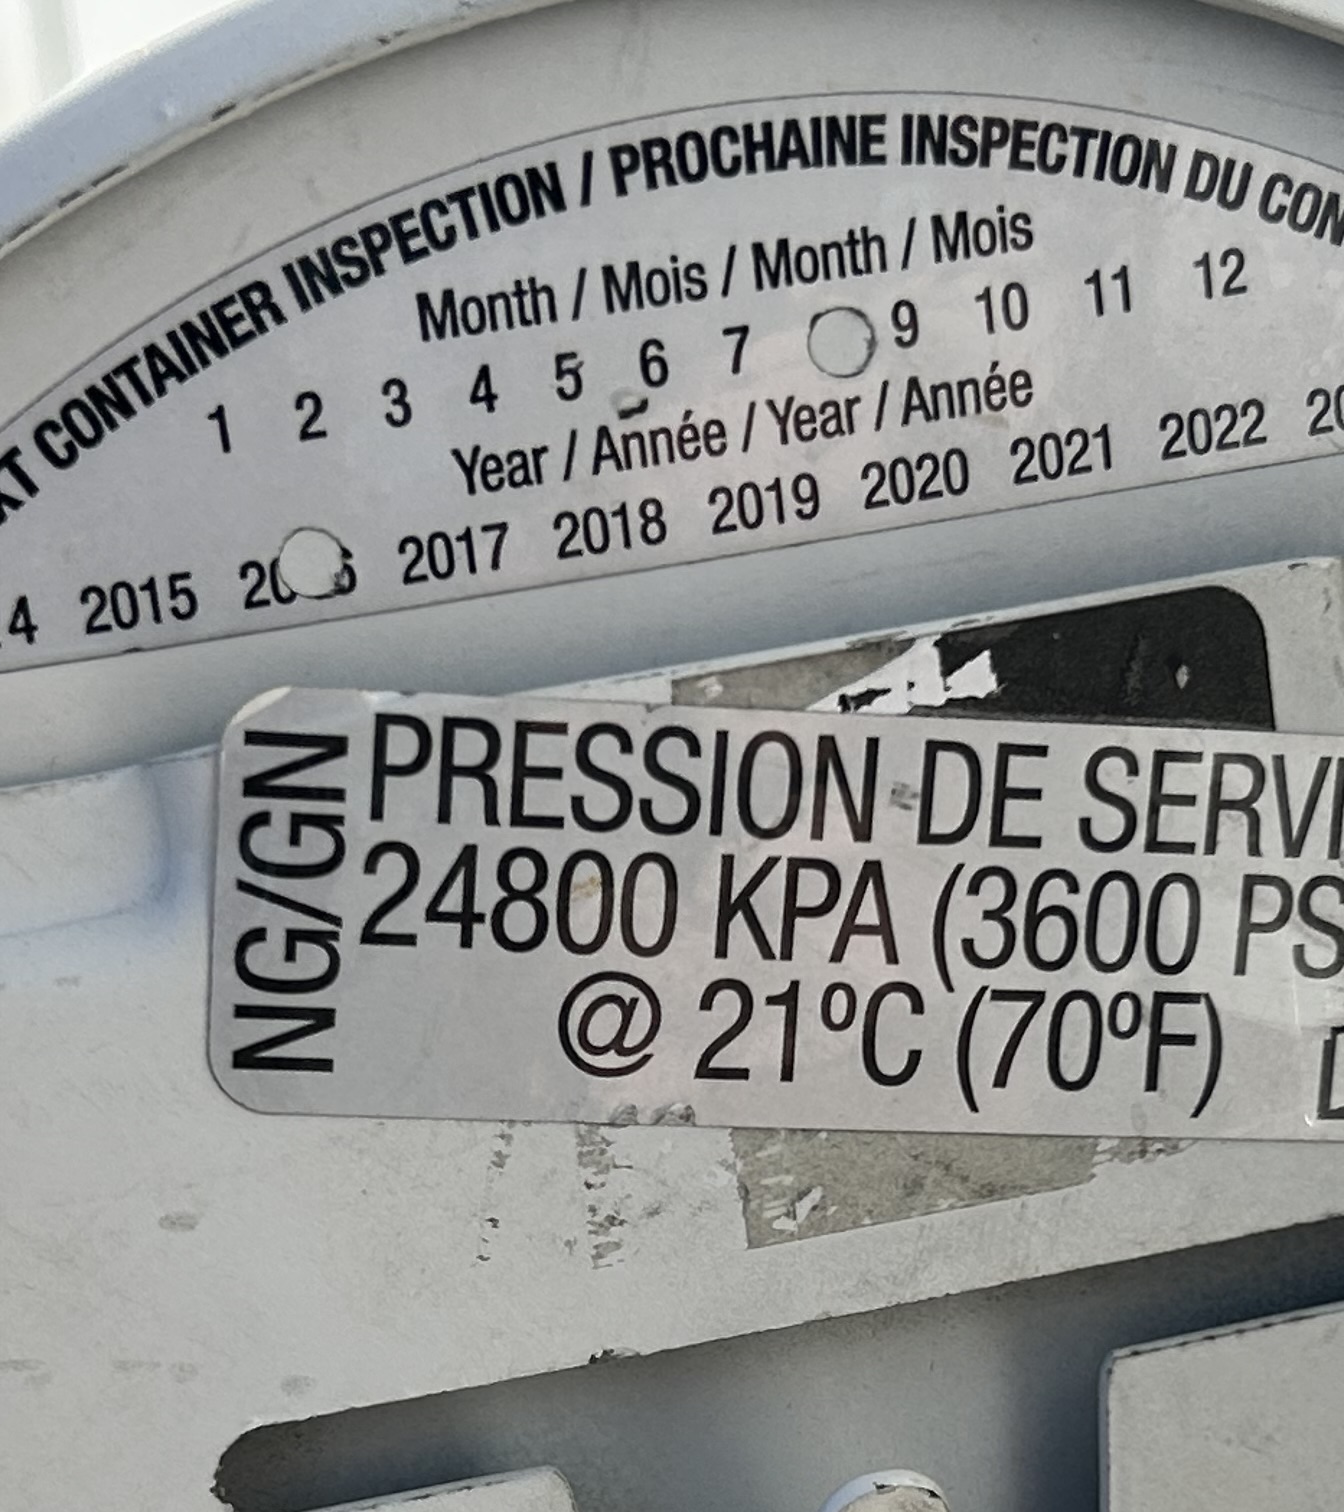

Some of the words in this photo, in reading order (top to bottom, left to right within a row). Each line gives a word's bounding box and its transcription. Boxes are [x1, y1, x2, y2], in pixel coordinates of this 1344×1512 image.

[32, 279, 288, 468] CONTAINER
[281, 161, 567, 313] INSPECTION
[580, 150, 593, 207] /
[607, 114, 887, 197] PROCHAINE
[901, 114, 1177, 193] INSPECTION
[1184, 149, 1253, 211] DU
[415, 276, 558, 342] Month
[572, 267, 587, 321] /
[601, 255, 708, 314] Mois
[721, 244, 736, 298] /
[751, 226, 887, 291] Month
[901, 217, 916, 270] /
[931, 205, 1033, 264] Mois
[207, 404, 231, 453] 1
[295, 391, 327, 442] 2
[382, 378, 412, 428] 3
[469, 364, 498, 413] 4
[555, 351, 584, 401] 5
[640, 338, 669, 388] 6
[722, 324, 749, 374] 7
[891, 299, 919, 349] 9
[975, 282, 1028, 334] 10
[1084, 265, 1131, 317] 11
[1194, 248, 1247, 299] 12
[451, 444, 549, 496] Year
[563, 429, 577, 482] /
[592, 408, 727, 475] Année
[742, 401, 756, 452] /
[766, 395, 861, 445] Year
[874, 380, 889, 431] /
[901, 360, 1033, 427] Année
[80, 571, 198, 635] 2015
[238, 546, 357, 610] 206
[398, 522, 509, 585] 2017
[553, 498, 666, 560] 2018
[708, 473, 819, 535] 2019
[861, 448, 969, 509] 2020
[1010, 423, 1112, 485] 2021
[1159, 398, 1267, 460] 2022
[370, 713, 880, 843] PRESSION
[917, 739, 1048, 849] DE
[230, 730, 349, 1073] NG/GN
[360, 841, 678, 958] 24800
[715, 854, 899, 965] KPA
[933, 863, 1200, 993] (3600
[558, 971, 662, 1078] @
